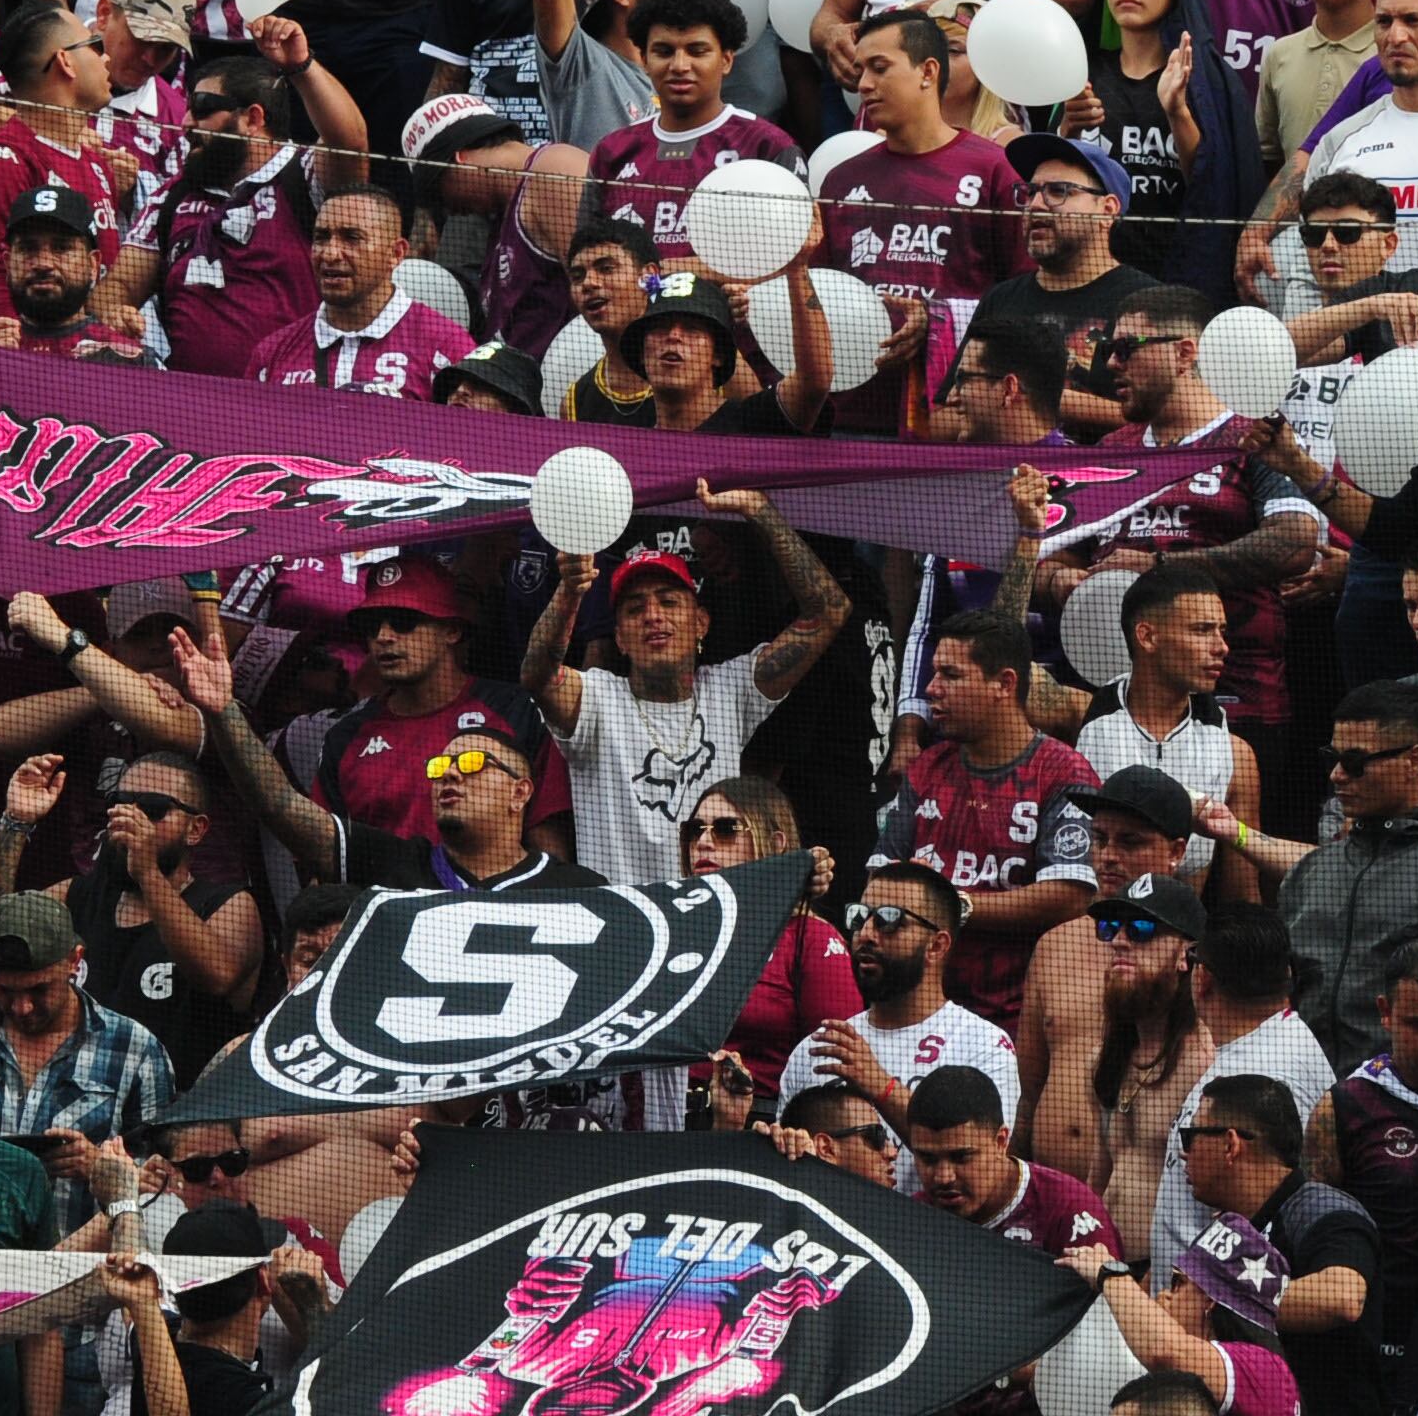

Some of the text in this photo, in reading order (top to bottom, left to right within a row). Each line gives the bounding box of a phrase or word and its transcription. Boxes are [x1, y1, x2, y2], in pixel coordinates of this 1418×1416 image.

[1224, 30, 1276, 72] 51
[956, 174, 983, 207] S
[652, 201, 688, 232] BA
[652, 231, 688, 244] CREDO
[888, 224, 952, 255] BAC
[886, 250, 947, 266] CREDOMATIC
[374, 352, 409, 388] S
[1188, 465, 1223, 495] S
[1129, 505, 1190, 531] BAC
[1009, 801, 1039, 843] S
[951, 851, 1027, 887] BAC
[375, 901, 607, 1043] S
[275, 1033, 380, 1095] SAN
[526, 1210, 870, 1292] LOS DEL SUR
